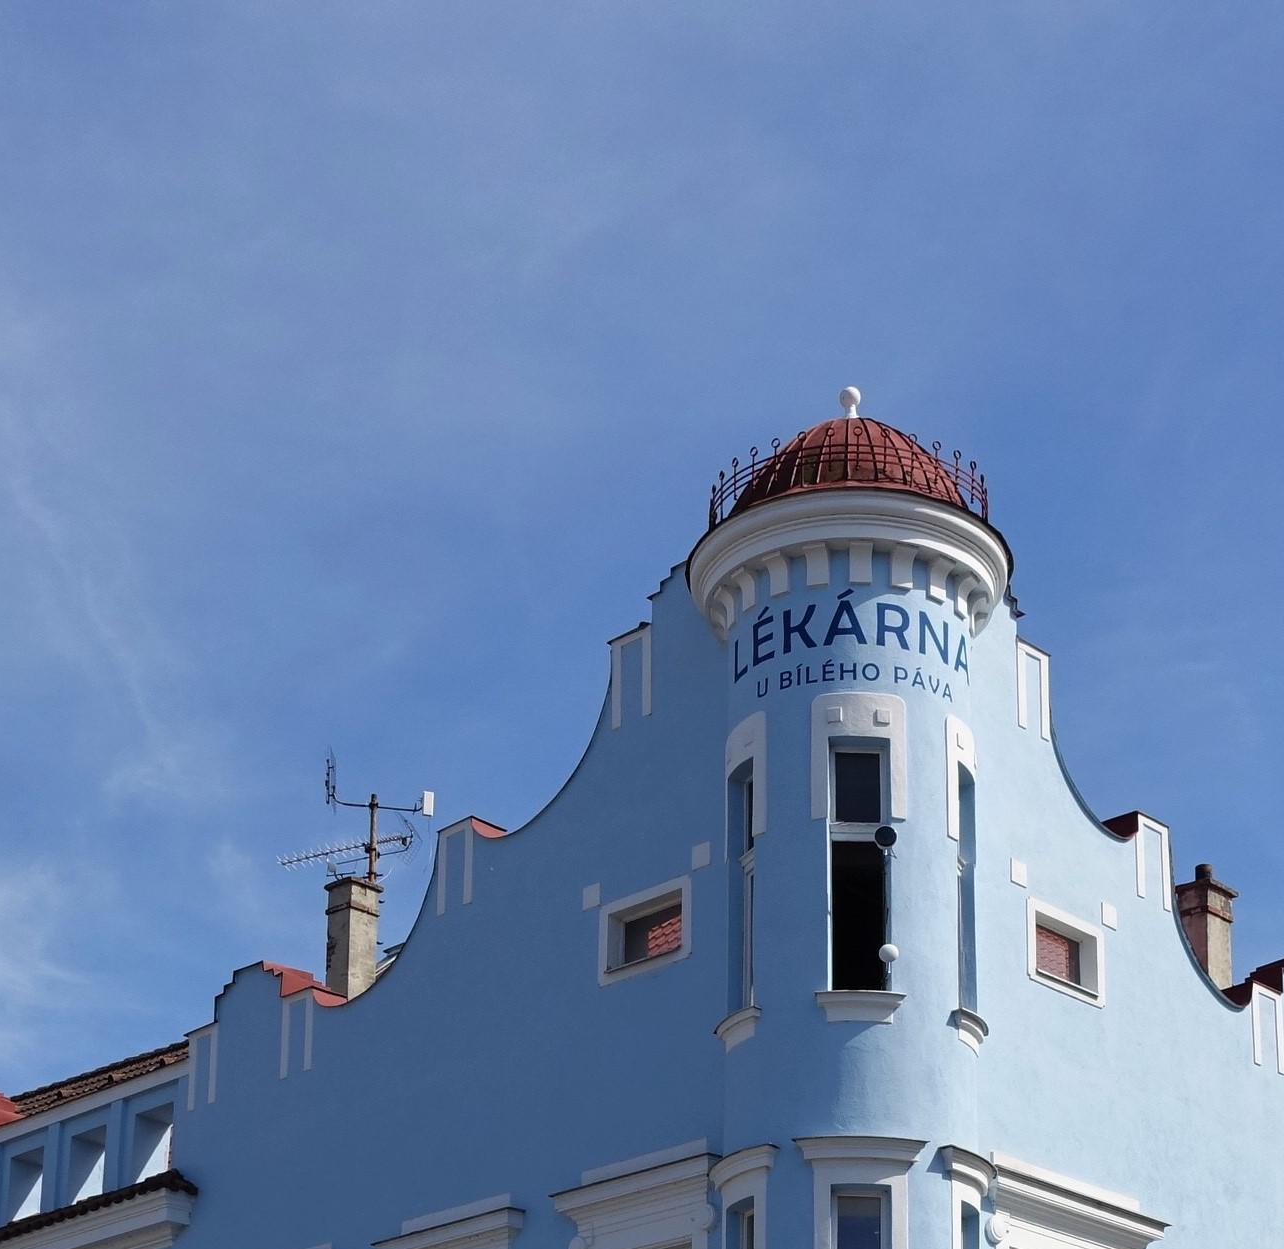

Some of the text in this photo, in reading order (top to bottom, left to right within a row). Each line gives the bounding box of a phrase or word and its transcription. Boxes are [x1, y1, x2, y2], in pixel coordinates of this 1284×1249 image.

[734, 588, 970, 686] LÉKÁRNA
[757, 659, 953, 702] U BÍLÉHO PÁVA
